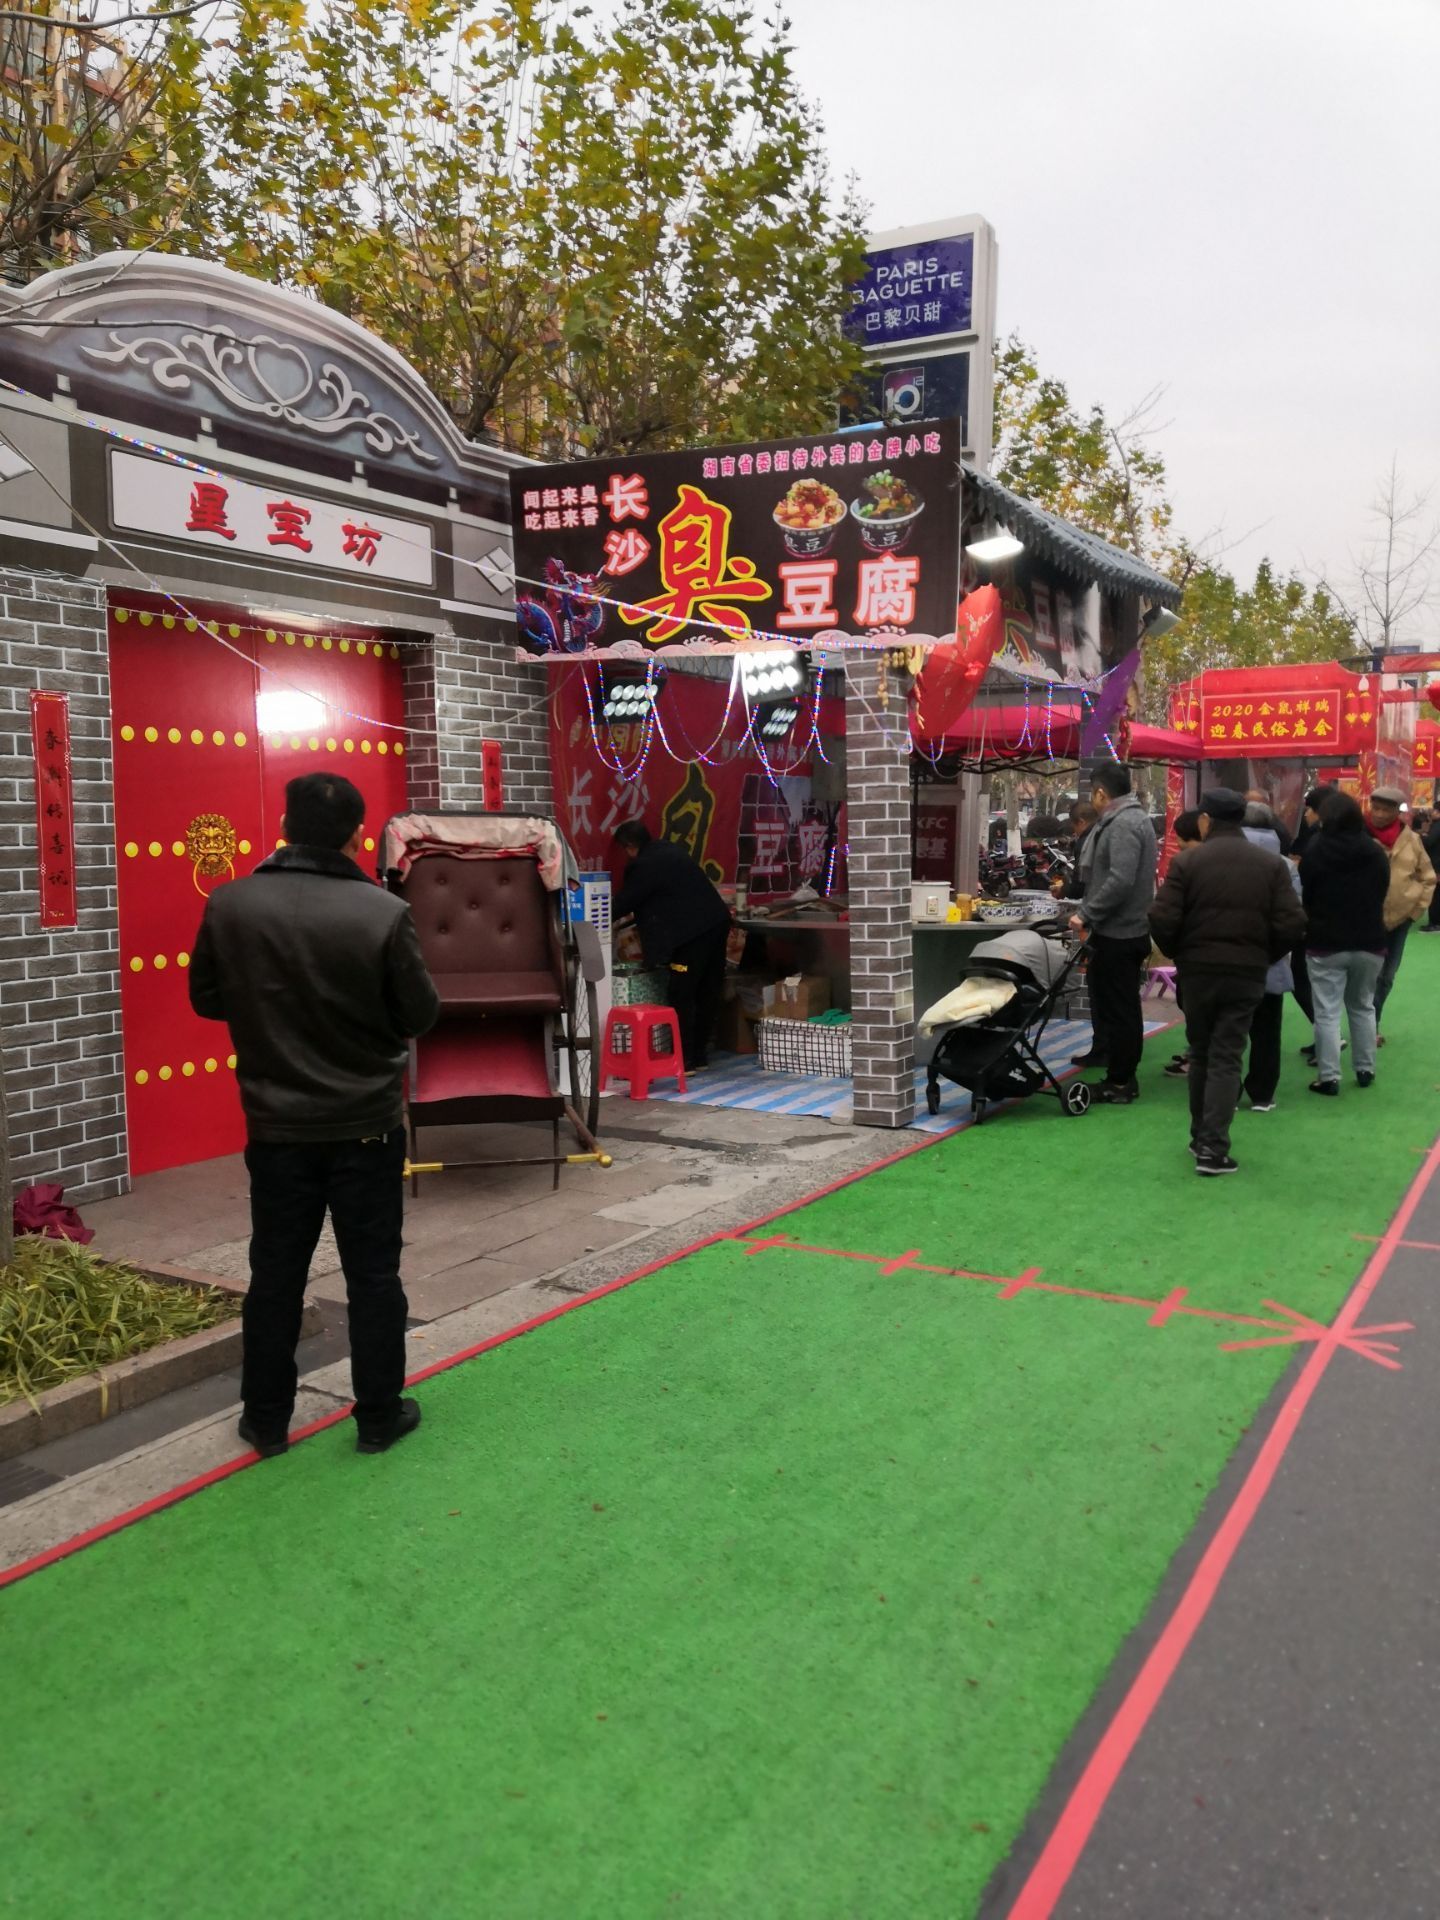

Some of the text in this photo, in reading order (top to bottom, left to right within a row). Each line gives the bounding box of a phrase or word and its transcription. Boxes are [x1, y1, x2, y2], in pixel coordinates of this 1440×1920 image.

[876, 257, 939, 283] PARIS
[865, 301, 942, 331] 巴黎贝甜
[702, 431, 941, 479] 湖南省委招待外宾的金牌小吃
[523, 484, 598, 510] 闻起来臭
[524, 507, 599, 531] 吃起来香
[602, 473, 651, 575] 长沙
[776, 551, 919, 629] 豆腐
[1210, 718, 1333, 740] 迎春民俗庙会
[567, 767, 650, 836] 长沙
